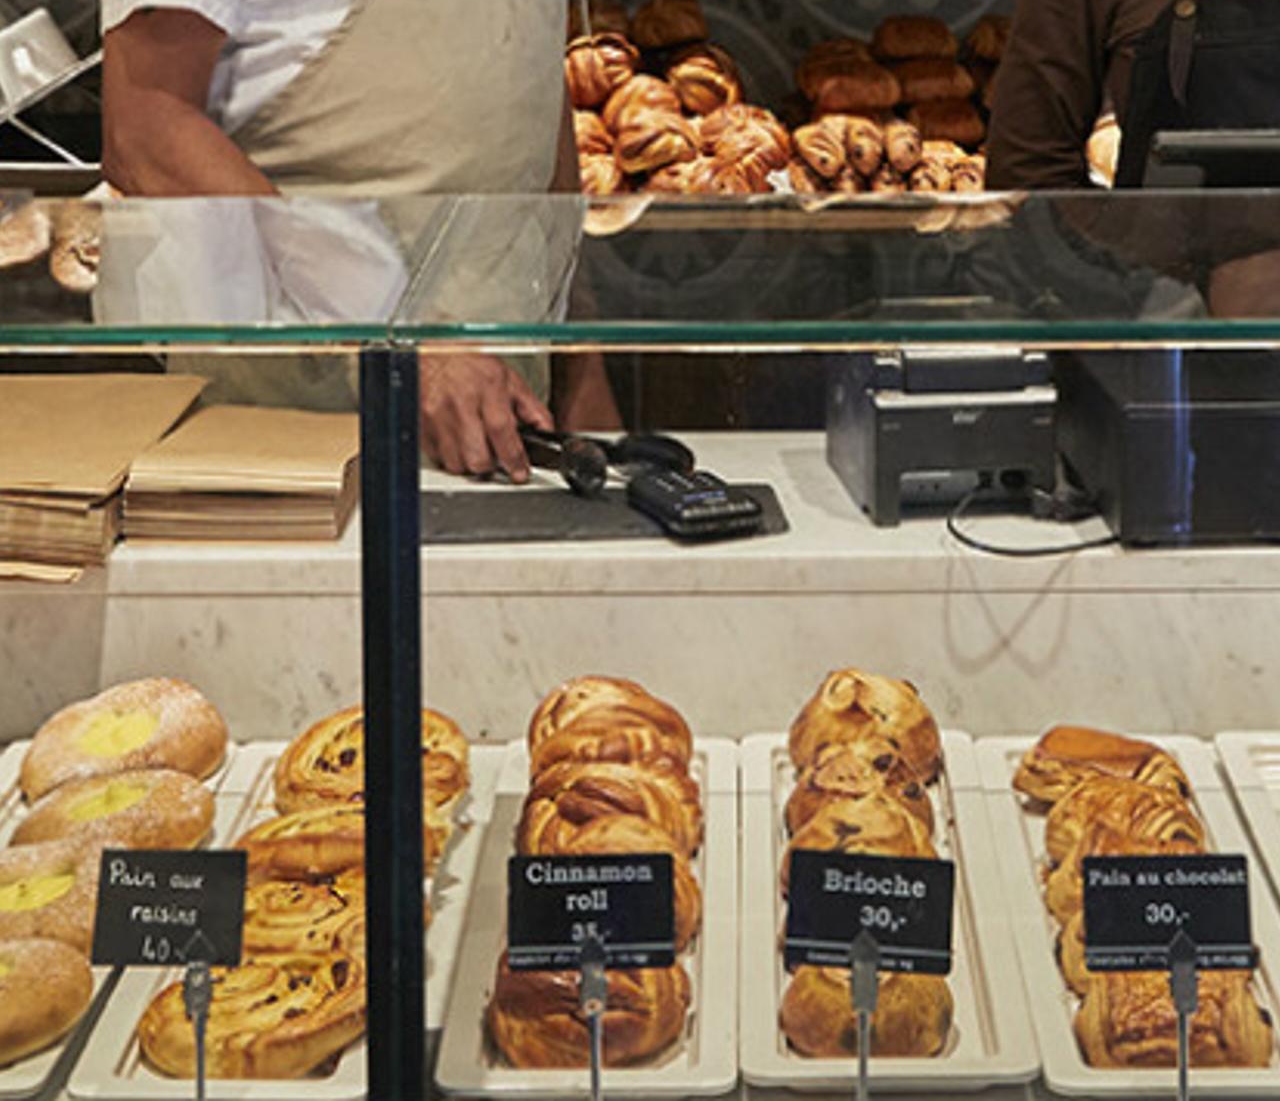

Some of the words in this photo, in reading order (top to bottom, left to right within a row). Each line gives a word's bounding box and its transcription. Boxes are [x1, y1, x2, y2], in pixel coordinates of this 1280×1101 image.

[109, 859, 156, 888] Pain
[525, 862, 653, 884] Cinnamon
[823, 868, 927, 898] Brioche
[1089, 869, 1131, 886] Pain
[1136, 872, 1161, 885] au
[1164, 868, 1246, 886] chocolat
[565, 889, 608, 911] roll
[130, 904, 197, 925] raisins
[860, 905, 908, 932] 30,-
[1145, 903, 1191, 925] 30,-
